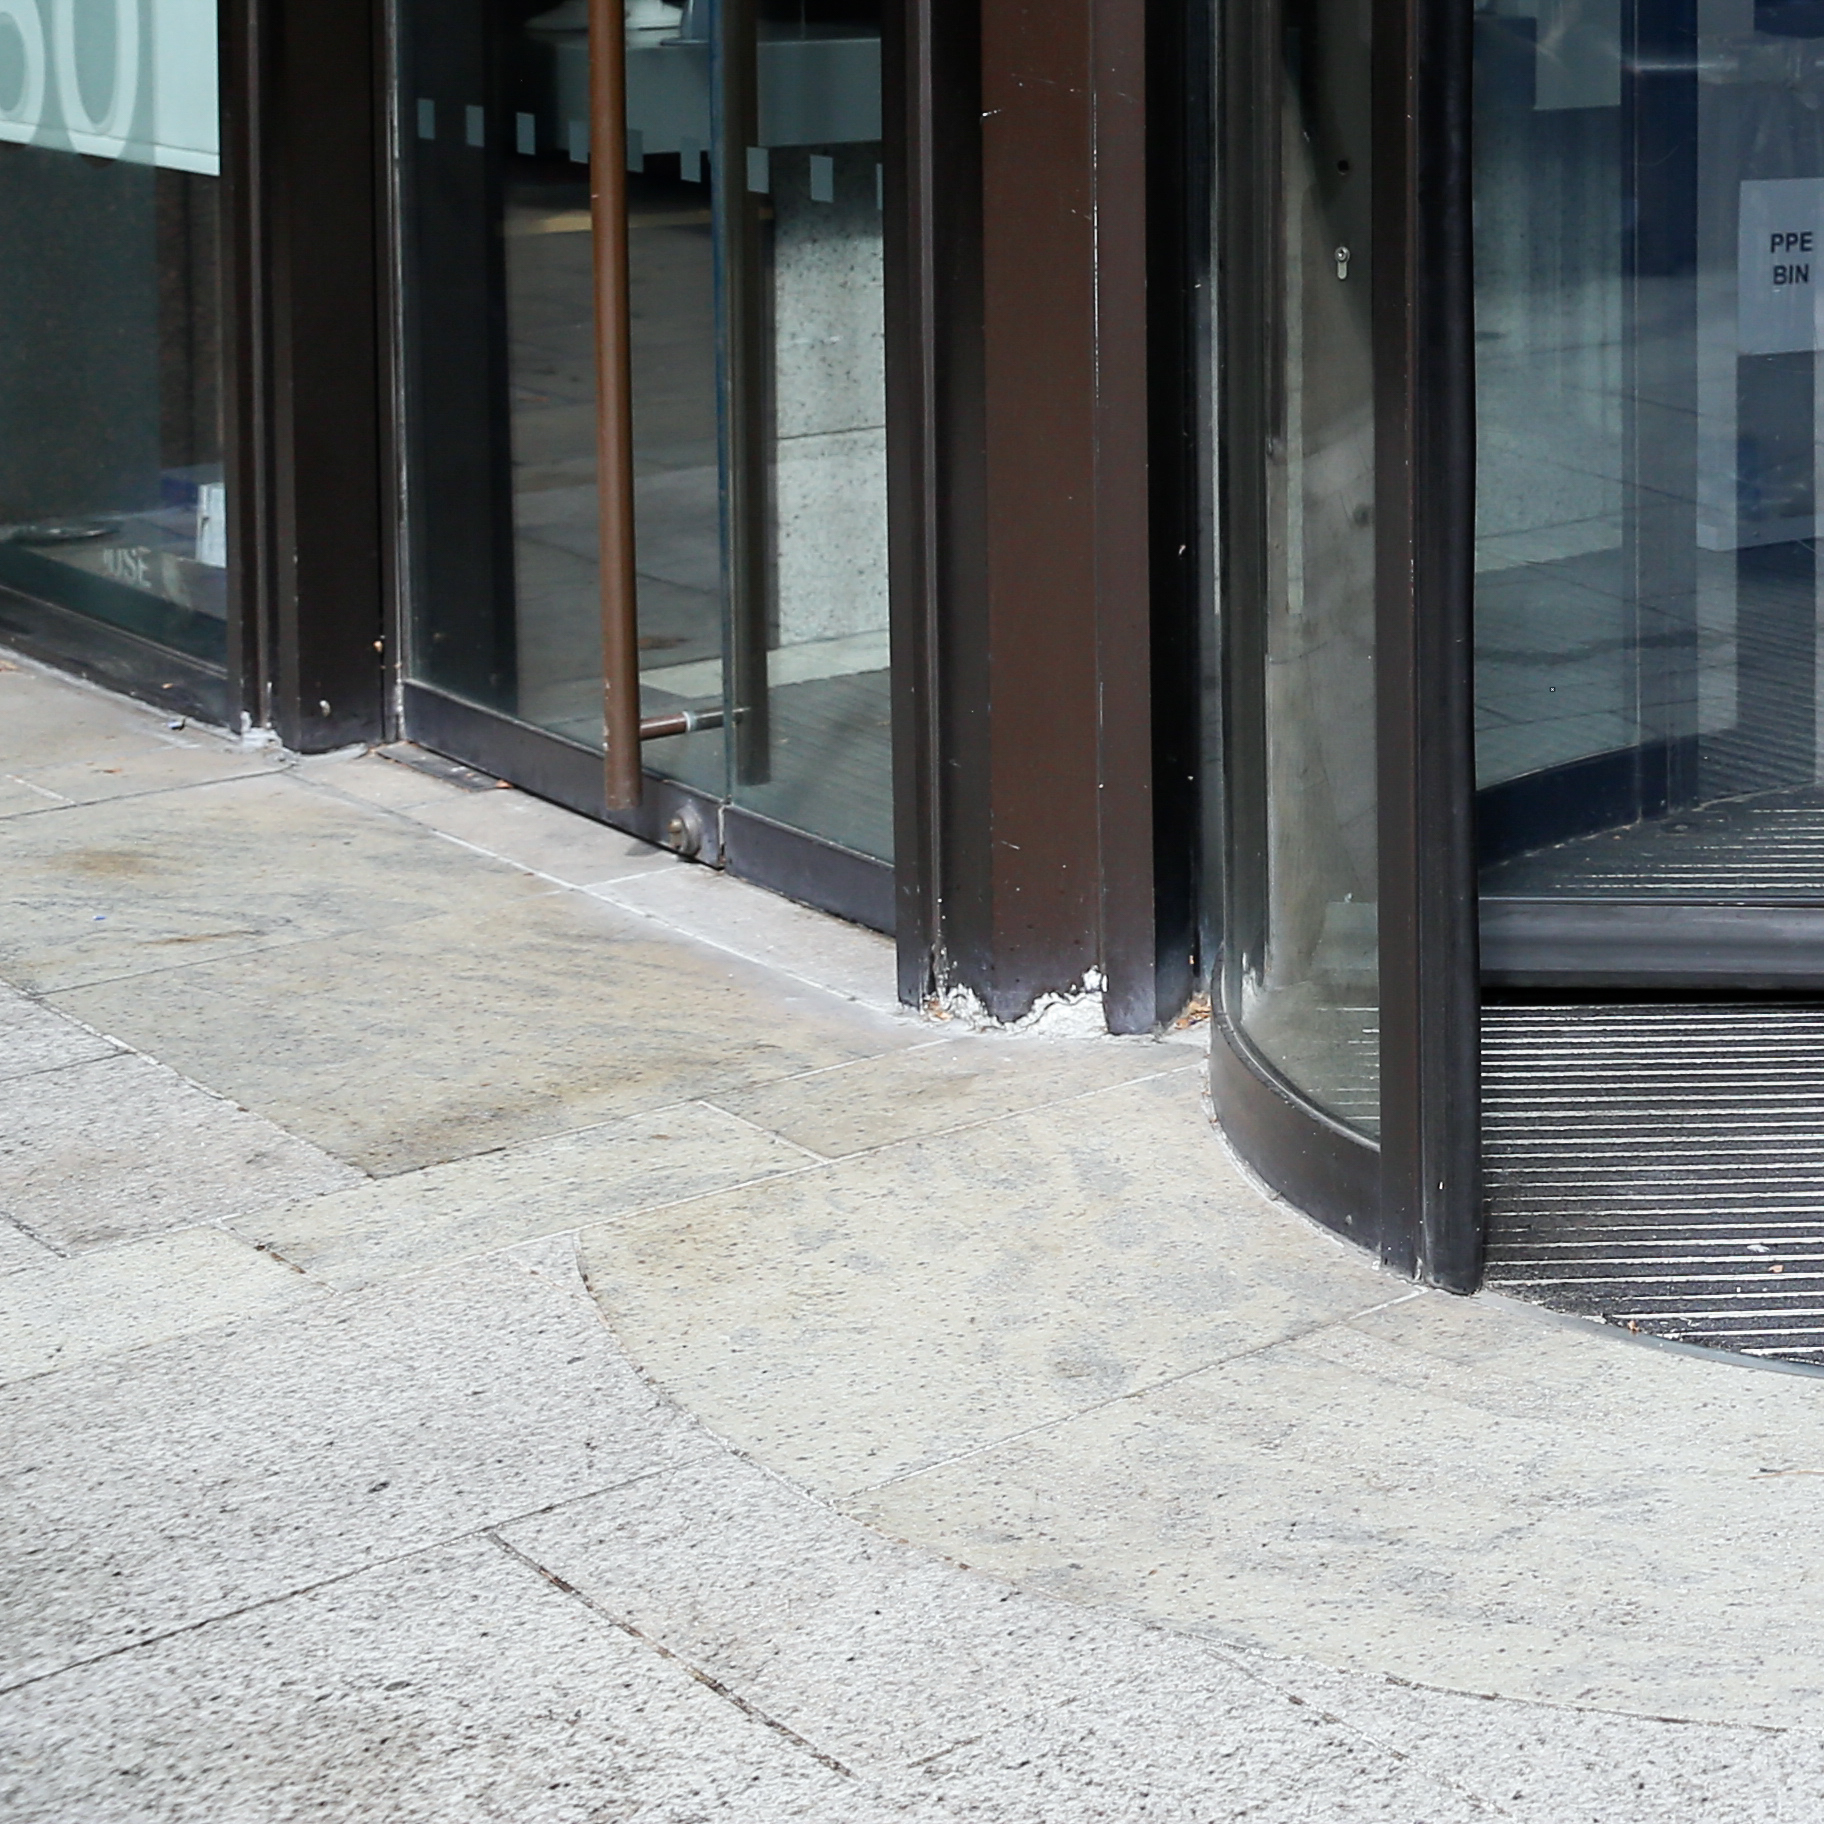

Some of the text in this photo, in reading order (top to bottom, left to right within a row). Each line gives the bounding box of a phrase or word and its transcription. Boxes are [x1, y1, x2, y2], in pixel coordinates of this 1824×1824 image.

[1770, 231, 1813, 254] PPE
[1773, 263, 1809, 286] BIN
[103, 546, 152, 588] USE
